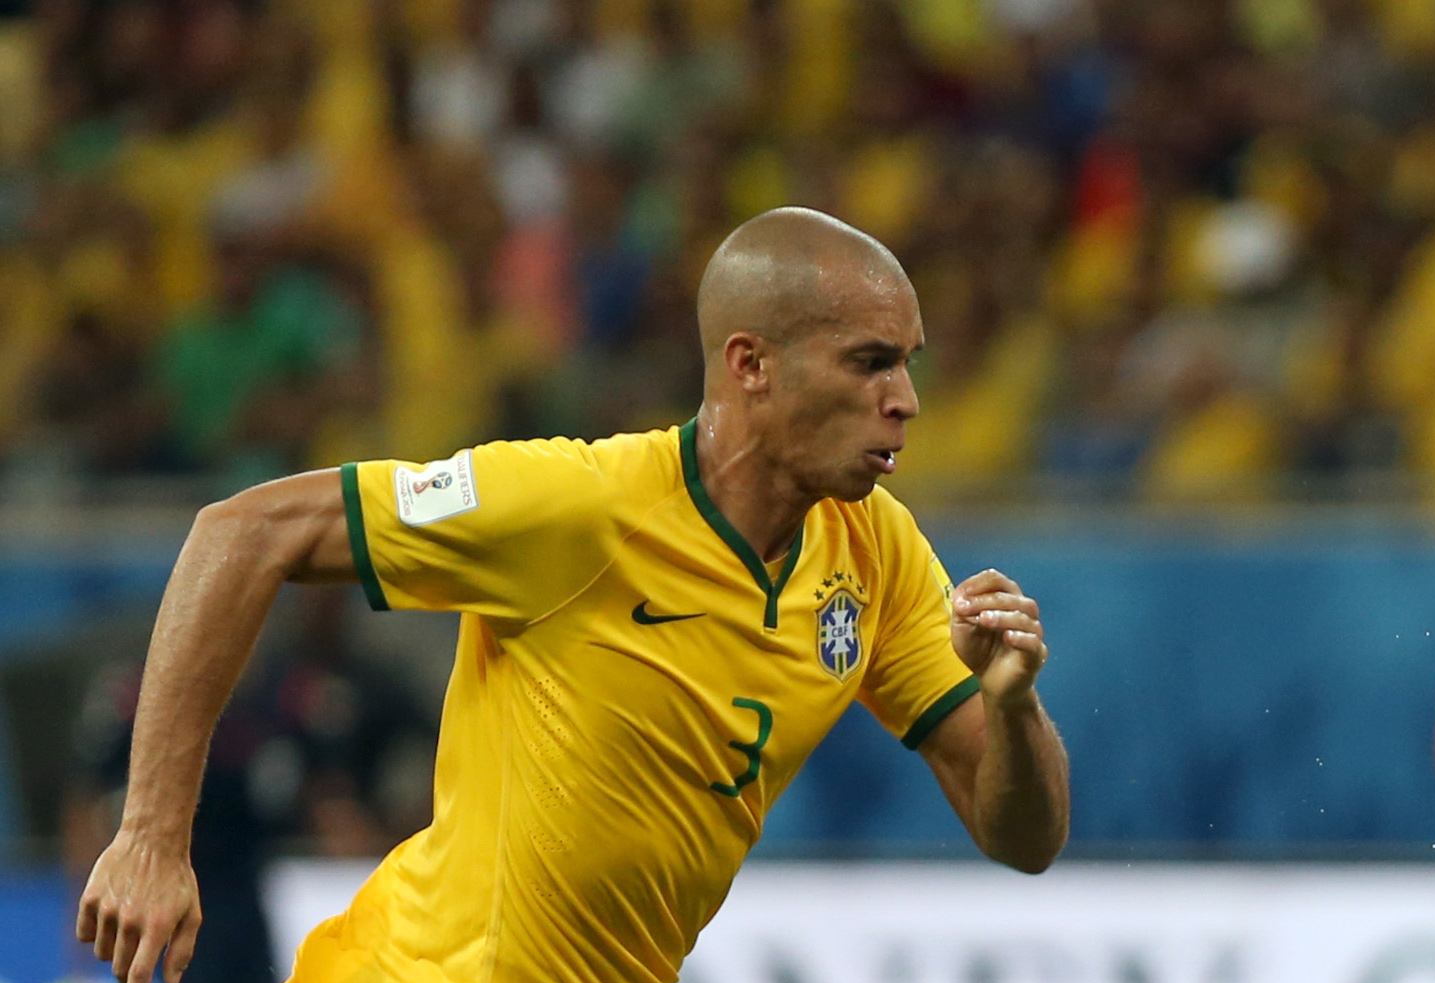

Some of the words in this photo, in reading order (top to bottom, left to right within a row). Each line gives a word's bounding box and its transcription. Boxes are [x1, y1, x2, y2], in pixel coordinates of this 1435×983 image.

[456, 453, 473, 506] UALIFIERS
[831, 625, 849, 638] CBF
[709, 696, 773, 798] 3
